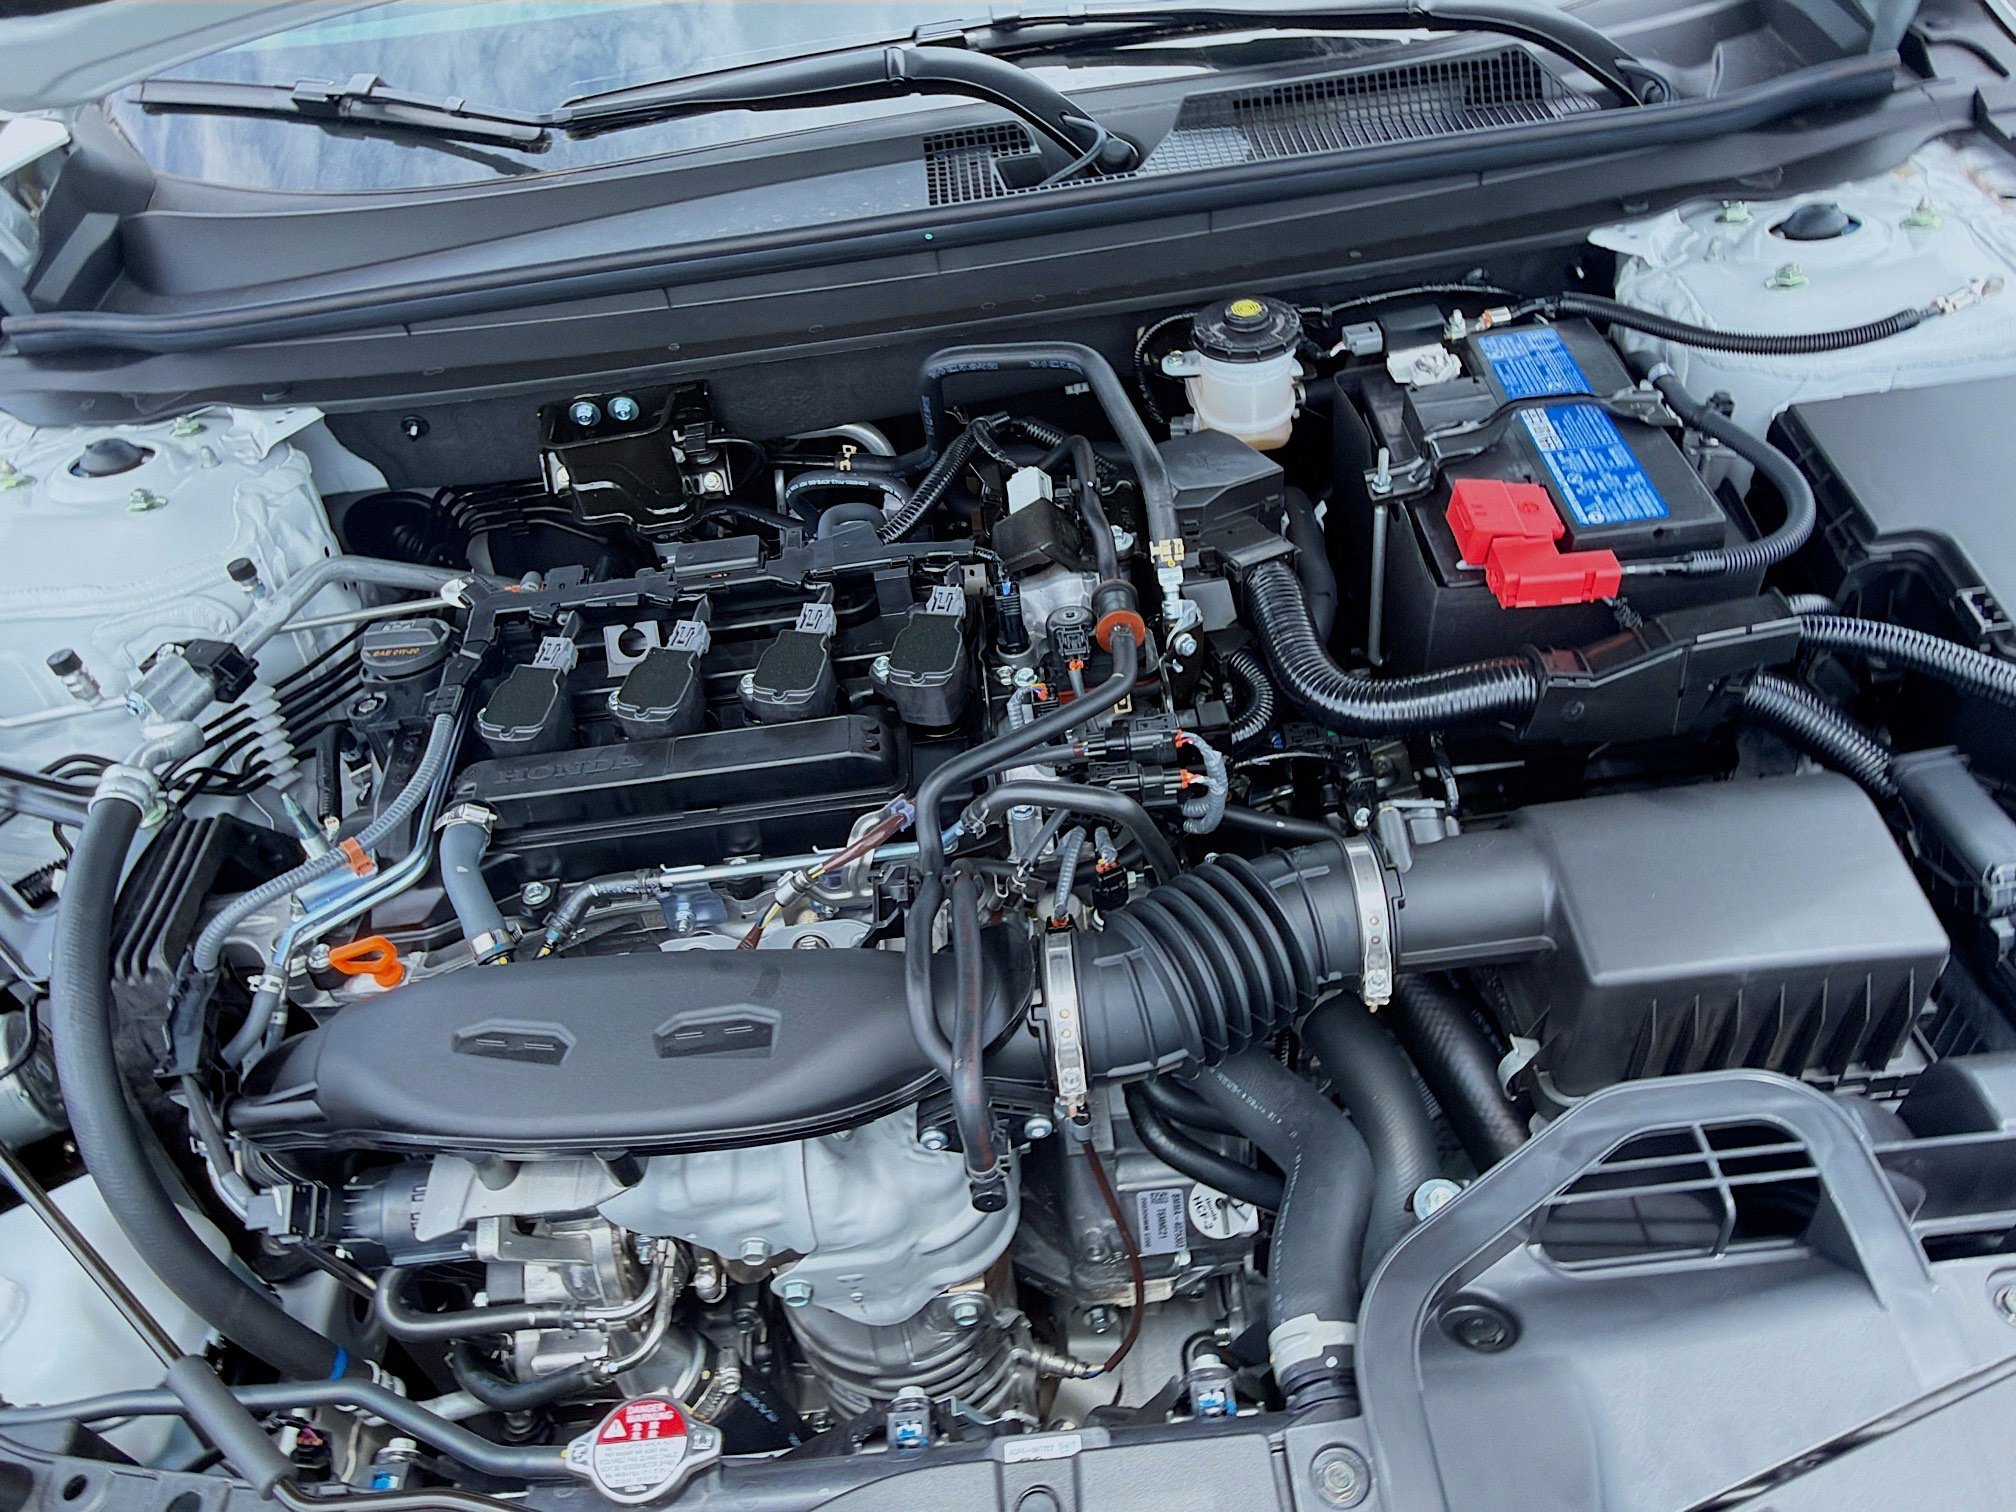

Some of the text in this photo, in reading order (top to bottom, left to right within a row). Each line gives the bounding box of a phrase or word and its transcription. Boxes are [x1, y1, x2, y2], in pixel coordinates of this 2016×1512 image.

[373, 649, 391, 657] SAE
[495, 754, 643, 784] HONDA
[626, 1403, 666, 1415] DANGER
[625, 1410, 675, 1423] WARNING
